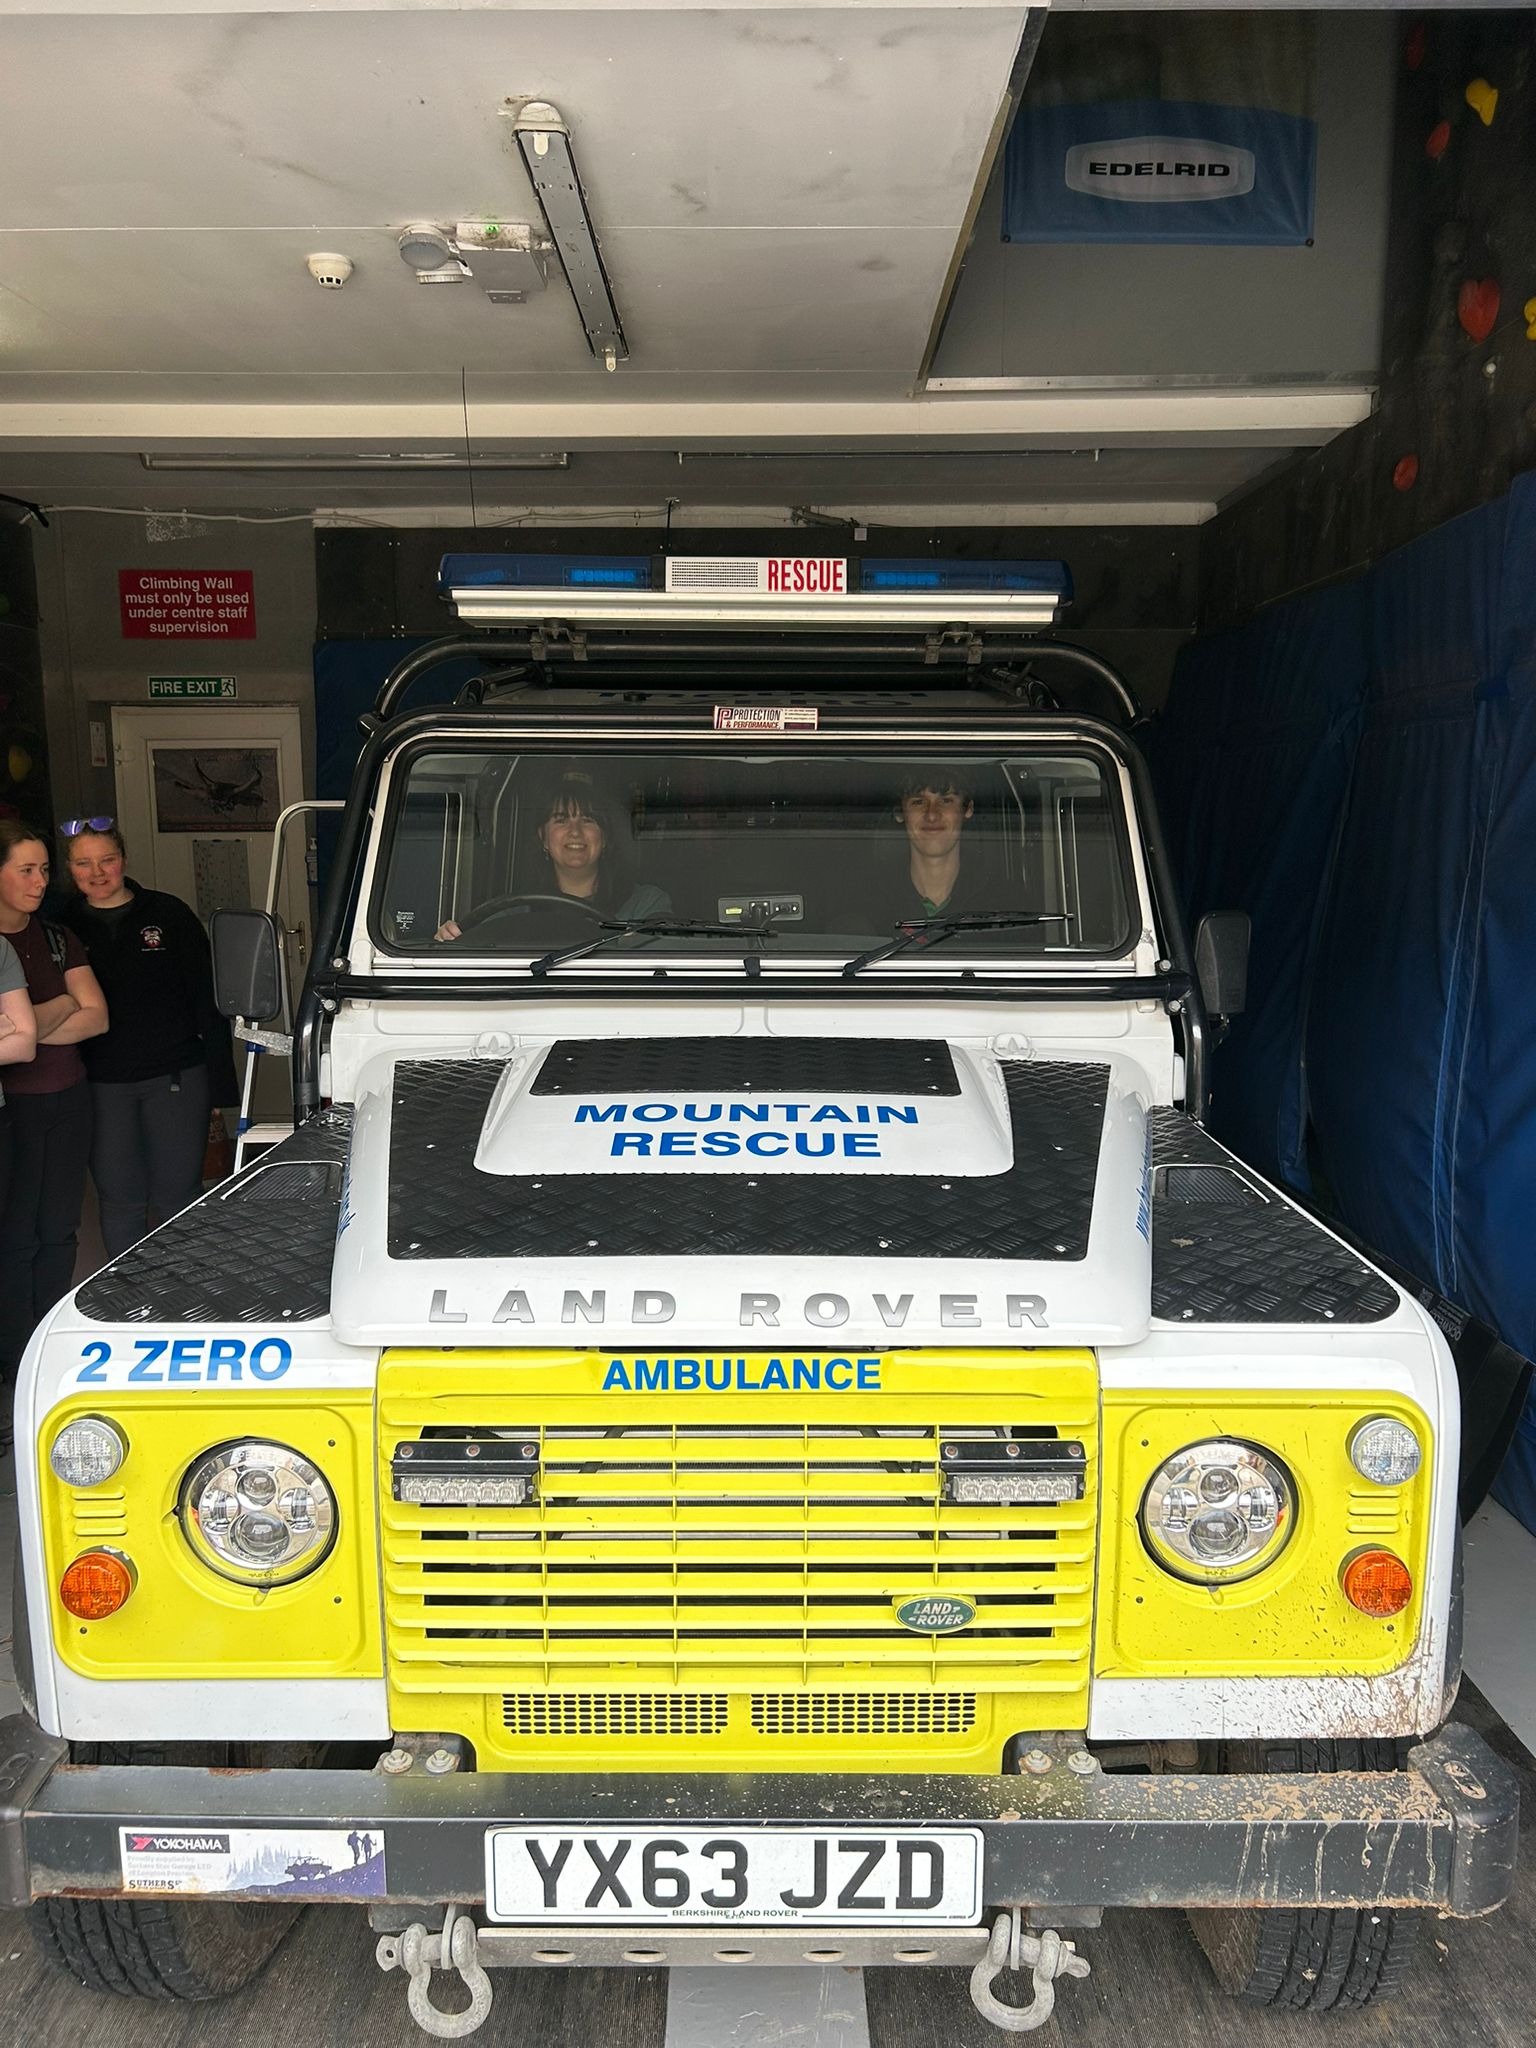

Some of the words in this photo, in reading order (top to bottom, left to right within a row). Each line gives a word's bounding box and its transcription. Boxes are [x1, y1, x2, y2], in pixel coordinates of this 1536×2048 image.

[1088, 162, 1231, 177] EDELRID
[767, 559, 844, 593] RESCUE
[139, 577, 200, 592] Climbing
[203, 577, 233, 589] Wall
[125, 593, 159, 604] must
[163, 592, 192, 606] only
[195, 592, 213, 604] be
[216, 592, 249, 604] used
[128, 607, 168, 618] under
[171, 608, 214, 618] centre
[217, 607, 248, 618] staff
[149, 621, 229, 635] supervision
[151, 681, 183, 693] FIRE
[187, 681, 217, 693] EXIT
[733, 708, 781, 721] PROTECTION
[574, 1103, 919, 1124] MOUNTAIN
[610, 1132, 882, 1158] RESCUE
[428, 1289, 677, 1325] LAND
[738, 1291, 1050, 1329] ROVER
[76, 1341, 112, 1383] 2
[127, 1337, 293, 1381] ZERO
[602, 1358, 882, 1391] AMBULANCE
[912, 1603, 952, 1615] LAND
[916, 1614, 964, 1625] ROVER
[153, 1838, 223, 1850] YOKOHAMA
[525, 1839, 748, 1908] YX63
[779, 1839, 944, 1909] JZD
[672, 1909, 731, 1917] BERKSHIRE
[732, 1909, 761, 1917] LAND
